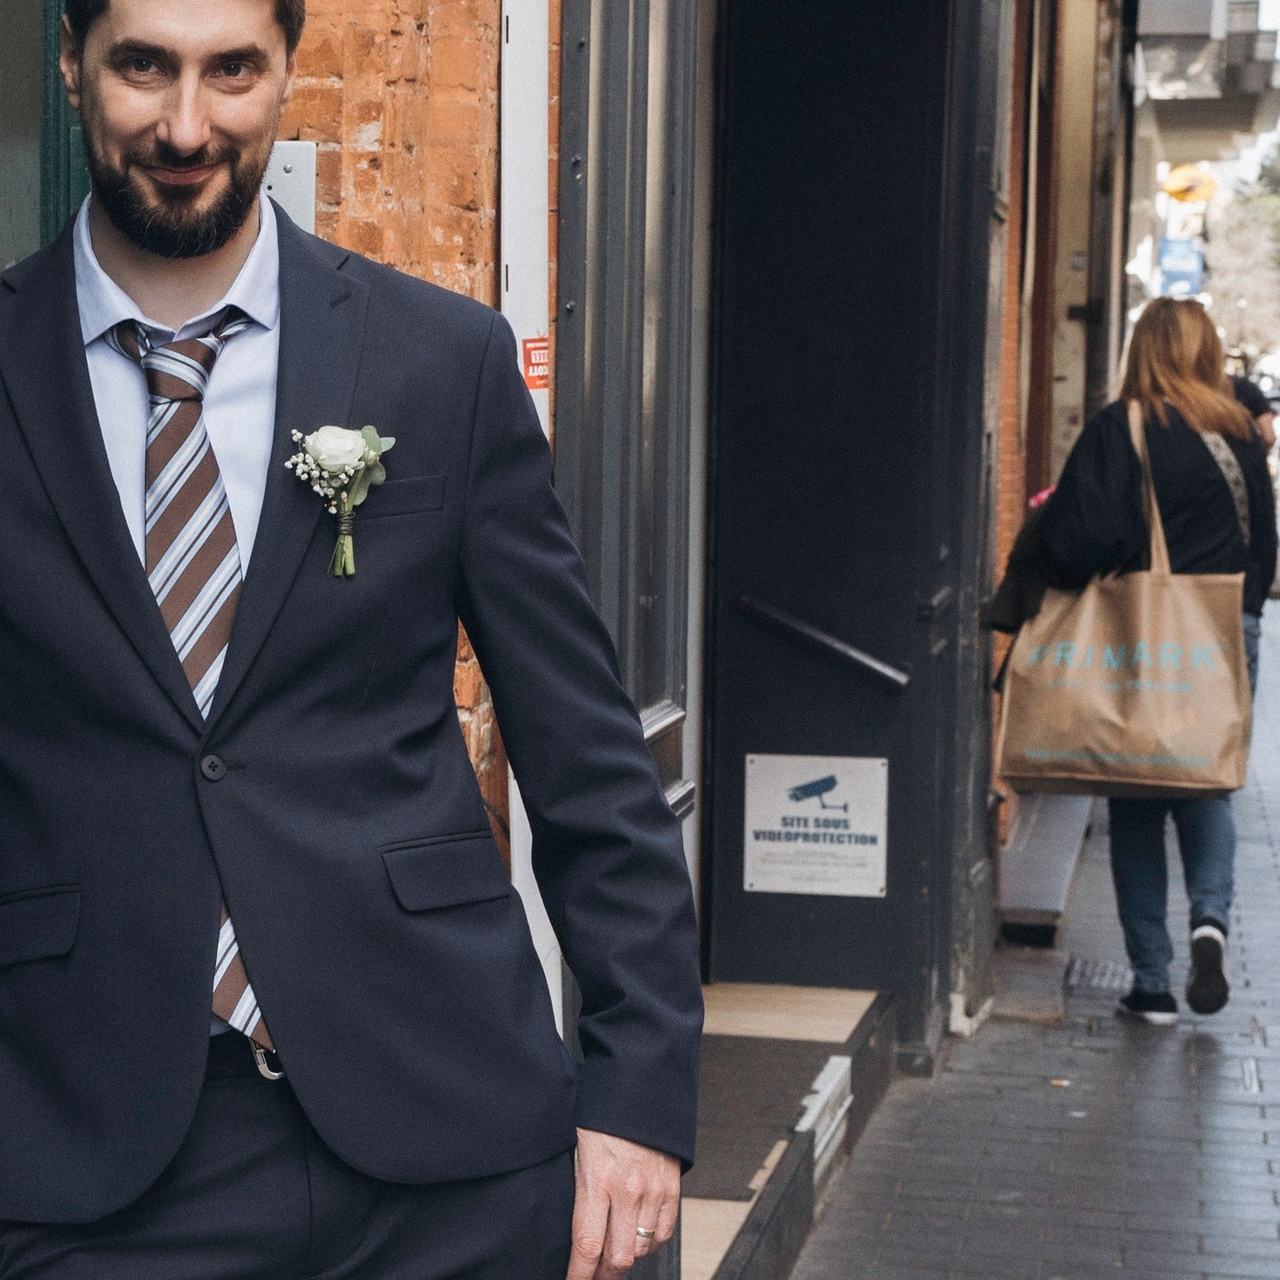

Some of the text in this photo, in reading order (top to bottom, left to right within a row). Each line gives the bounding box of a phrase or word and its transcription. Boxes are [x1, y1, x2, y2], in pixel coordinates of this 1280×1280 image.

[781, 816, 850, 830] SITE SOUS
[753, 830, 878, 845] VIDEOPROTECTION
